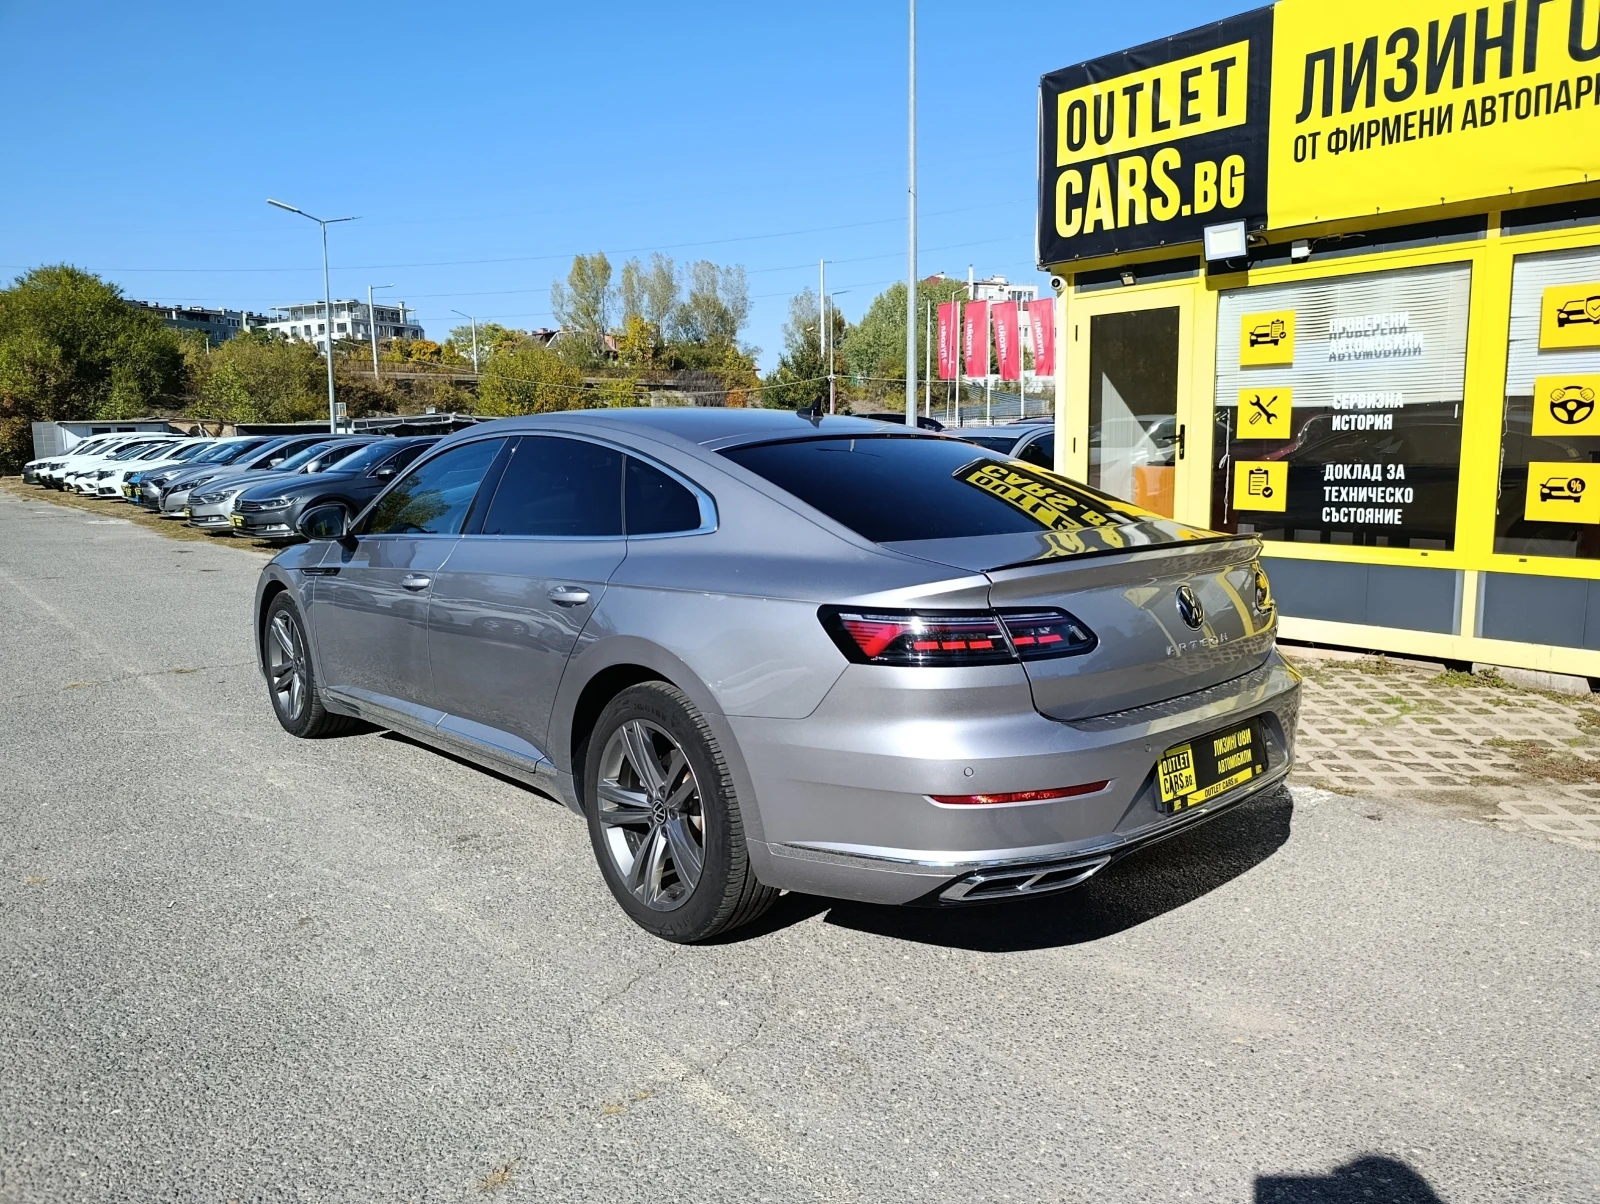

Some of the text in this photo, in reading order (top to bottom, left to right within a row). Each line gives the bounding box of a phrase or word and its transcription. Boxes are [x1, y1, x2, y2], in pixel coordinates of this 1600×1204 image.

[1066, 56, 1237, 152] OUTLET
[1293, 131, 1321, 163] ОТ
[1327, 103, 1454, 156] ФИРМЕНИ
[1055, 147, 1245, 238] CARS.BG
[1329, 311, 1409, 335] ПРОВЕРЕНИ
[1329, 332, 1423, 354] АВТОМОБИЛИ
[1331, 392, 1404, 410] СЕРВИЗНА
[1332, 414, 1393, 431] ИСТОРИЯ
[1323, 464, 1405, 481] ДОКЛАД ЗА
[1323, 486, 1414, 503] ТЕХНИЧЕСКО
[1322, 507, 1403, 525] СЪСТОЯНИЕ
[1165, 633, 1228, 656] ARTEON
[1162, 753, 1189, 774] OUTLET
[1163, 773, 1193, 795] CARS.BG
[1204, 782, 1222, 797] OUTLET
